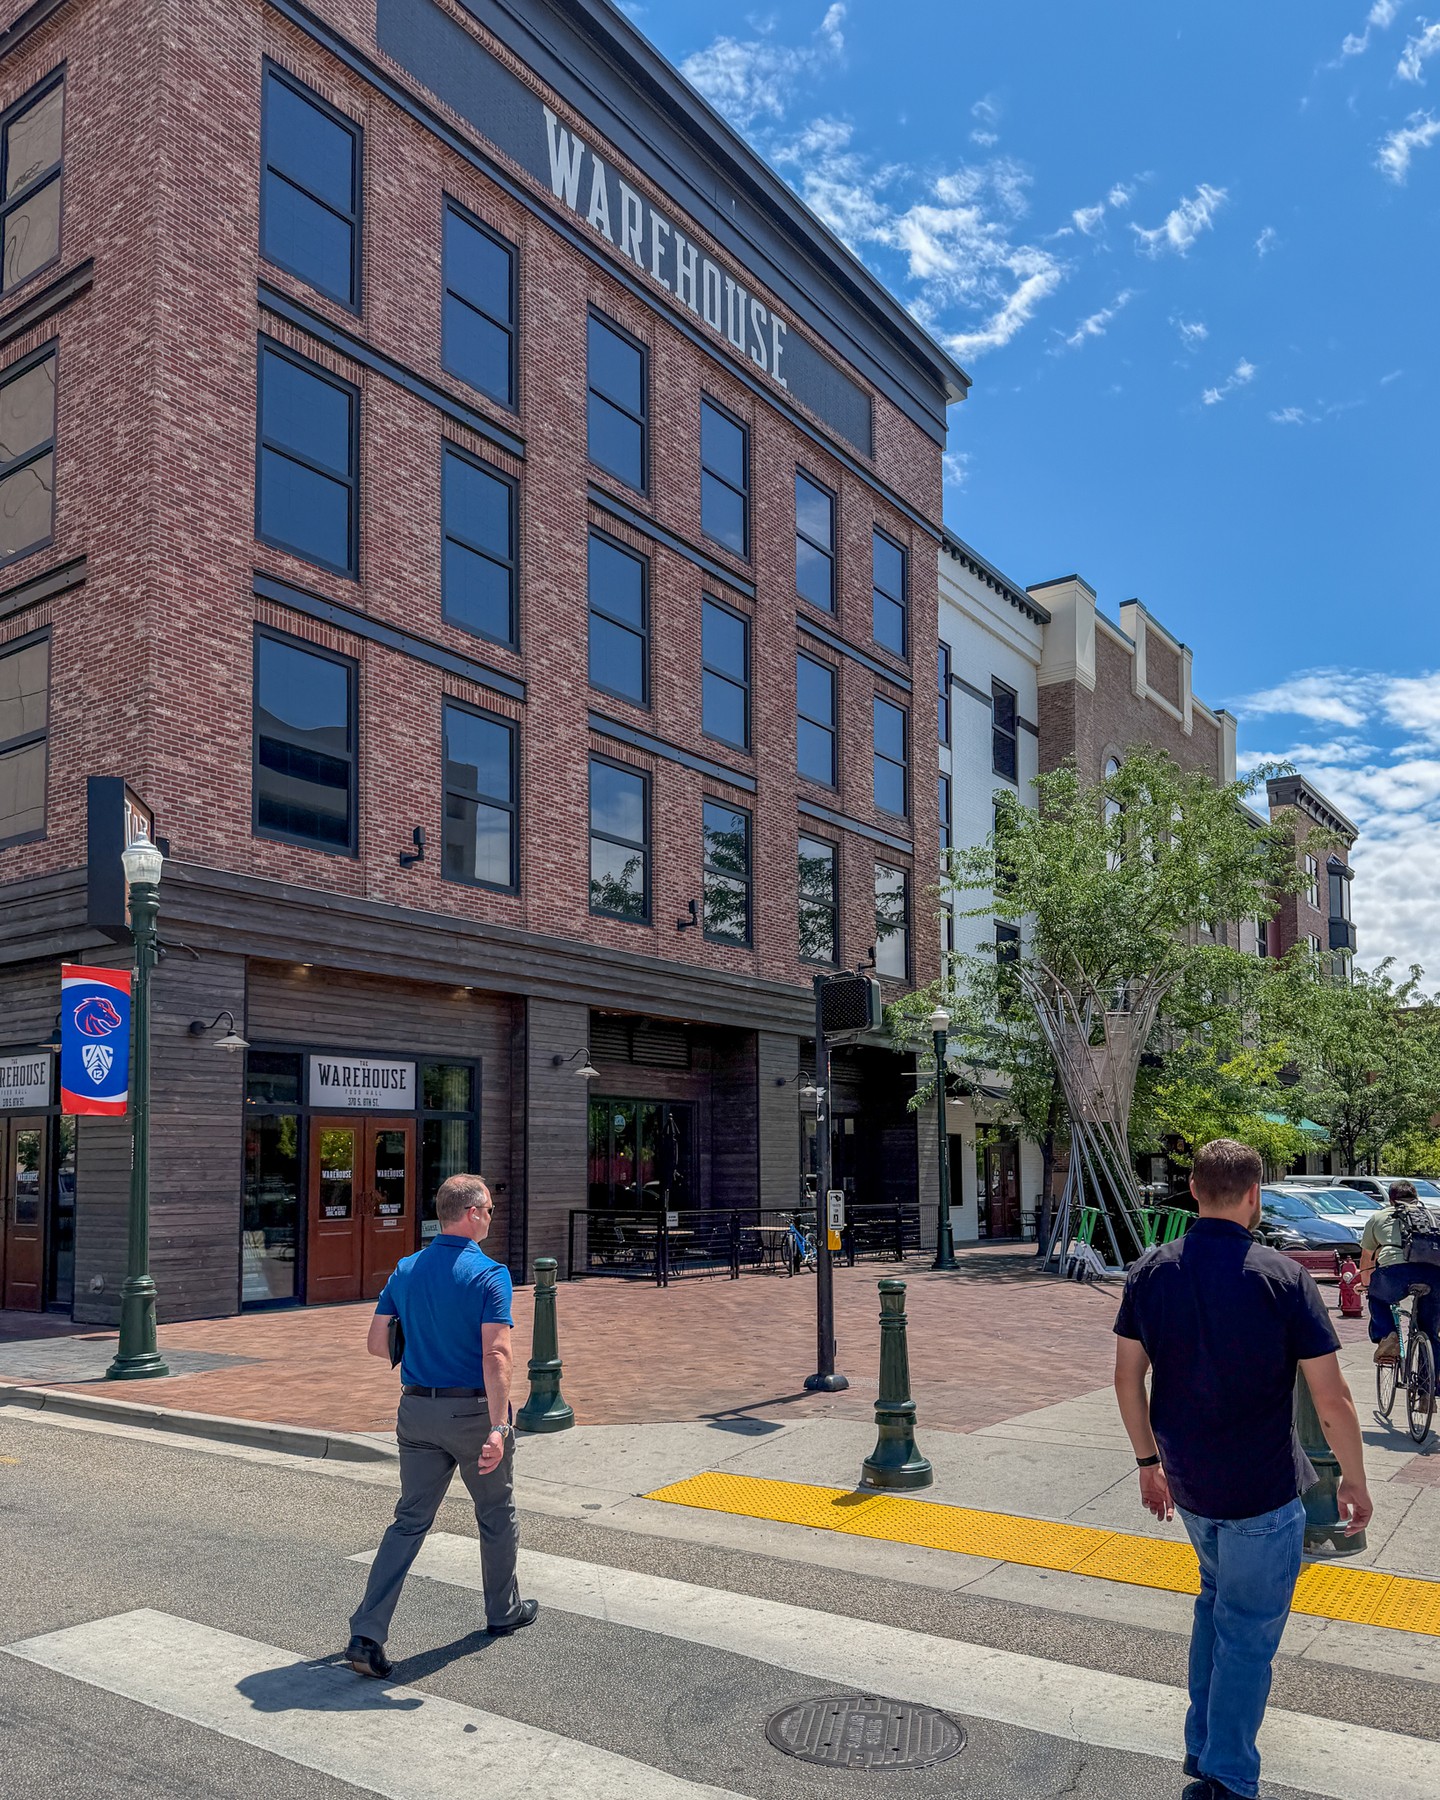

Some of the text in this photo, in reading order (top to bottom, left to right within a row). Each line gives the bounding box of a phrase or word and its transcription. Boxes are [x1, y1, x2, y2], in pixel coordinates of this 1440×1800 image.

[543, 104, 788, 389] WAREHOUSE
[82, 1044, 114, 1069] PAC
[93, 1069, 103, 1079] 12
[318, 1063, 407, 1090] WAREHOUSE
